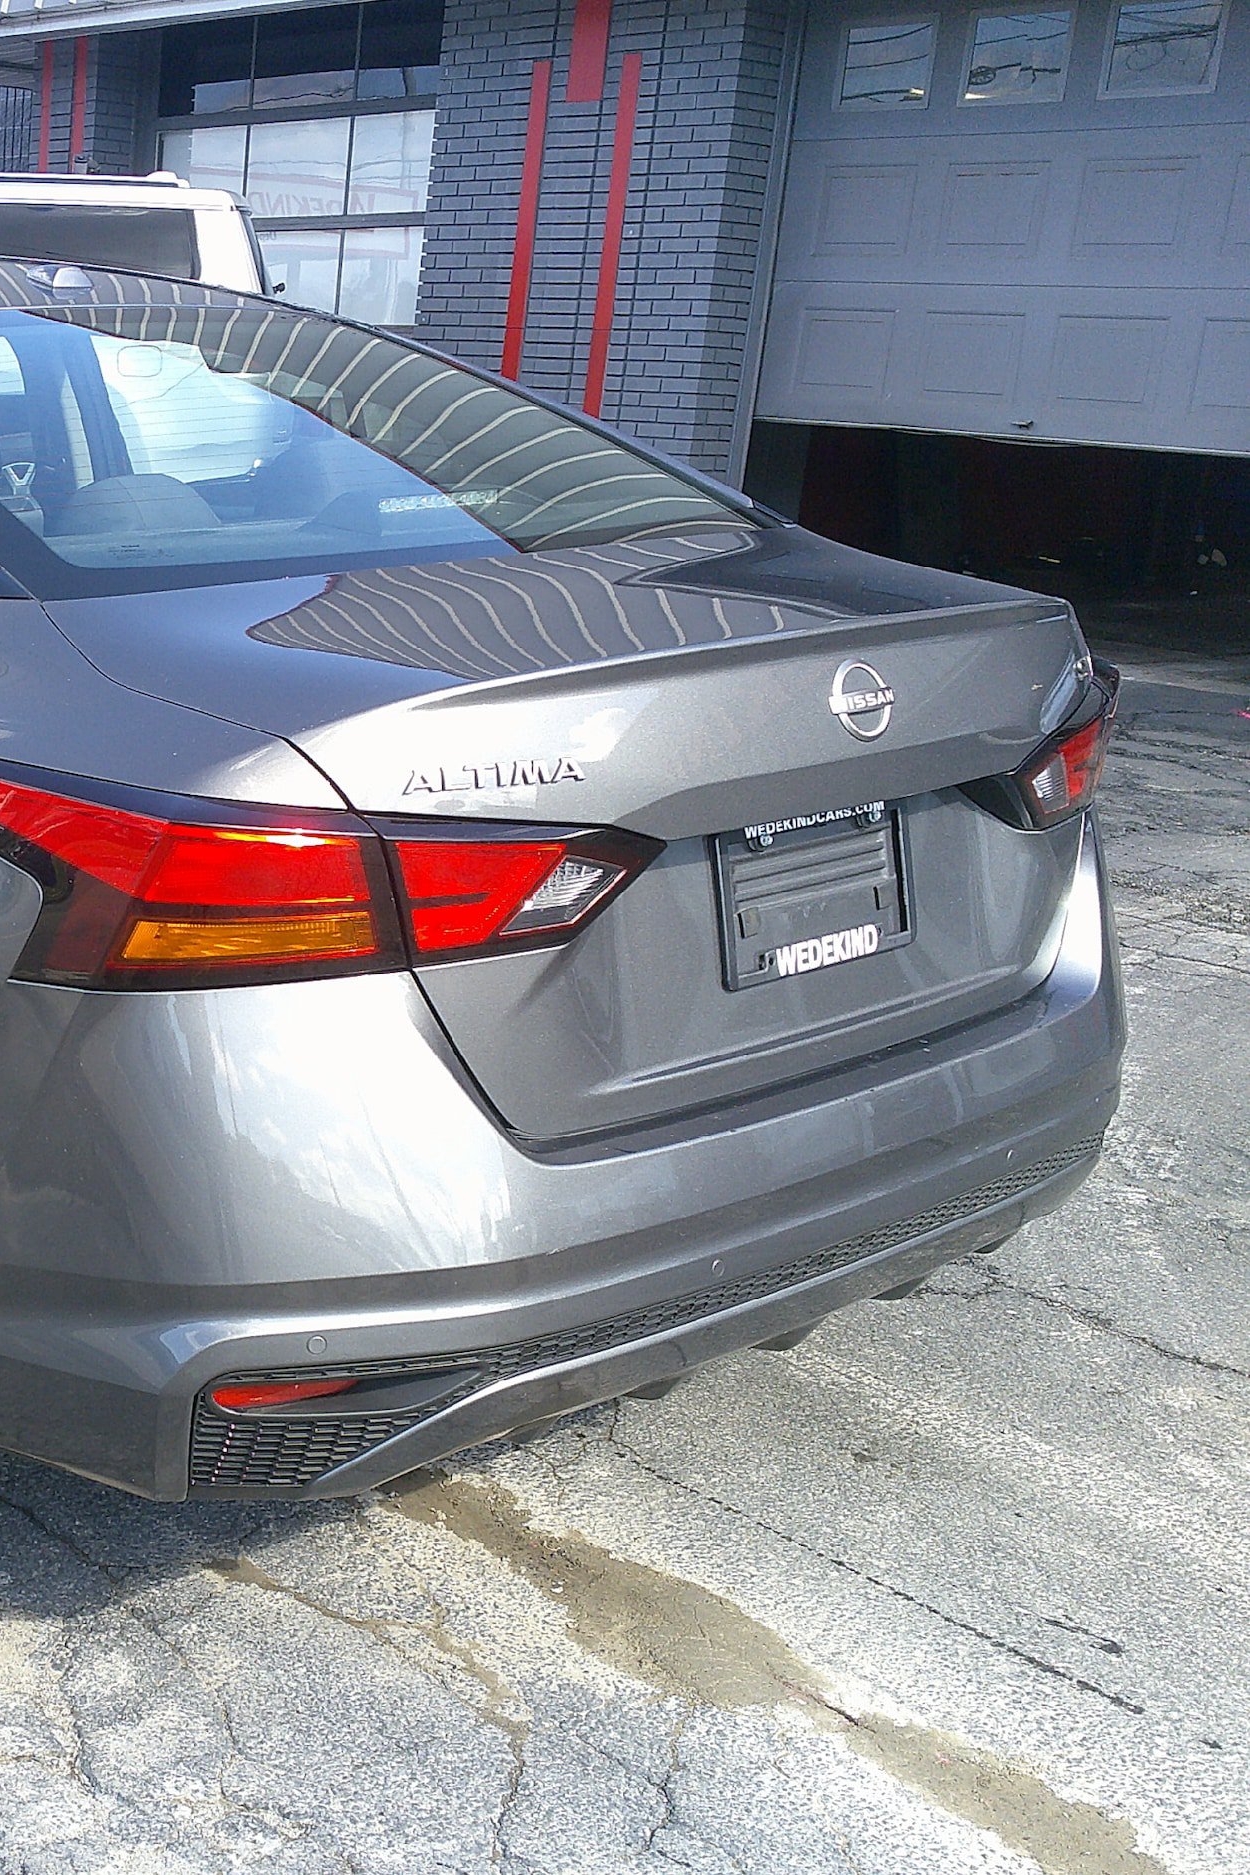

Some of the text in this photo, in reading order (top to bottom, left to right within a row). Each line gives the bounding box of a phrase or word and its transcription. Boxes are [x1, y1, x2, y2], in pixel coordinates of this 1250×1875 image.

[833, 688, 894, 712] ISSAN
[402, 756, 587, 796] ALTIMA
[744, 800, 885, 840] WEDEKINDCARS.COM
[776, 924, 879, 977] WEDEKIND
